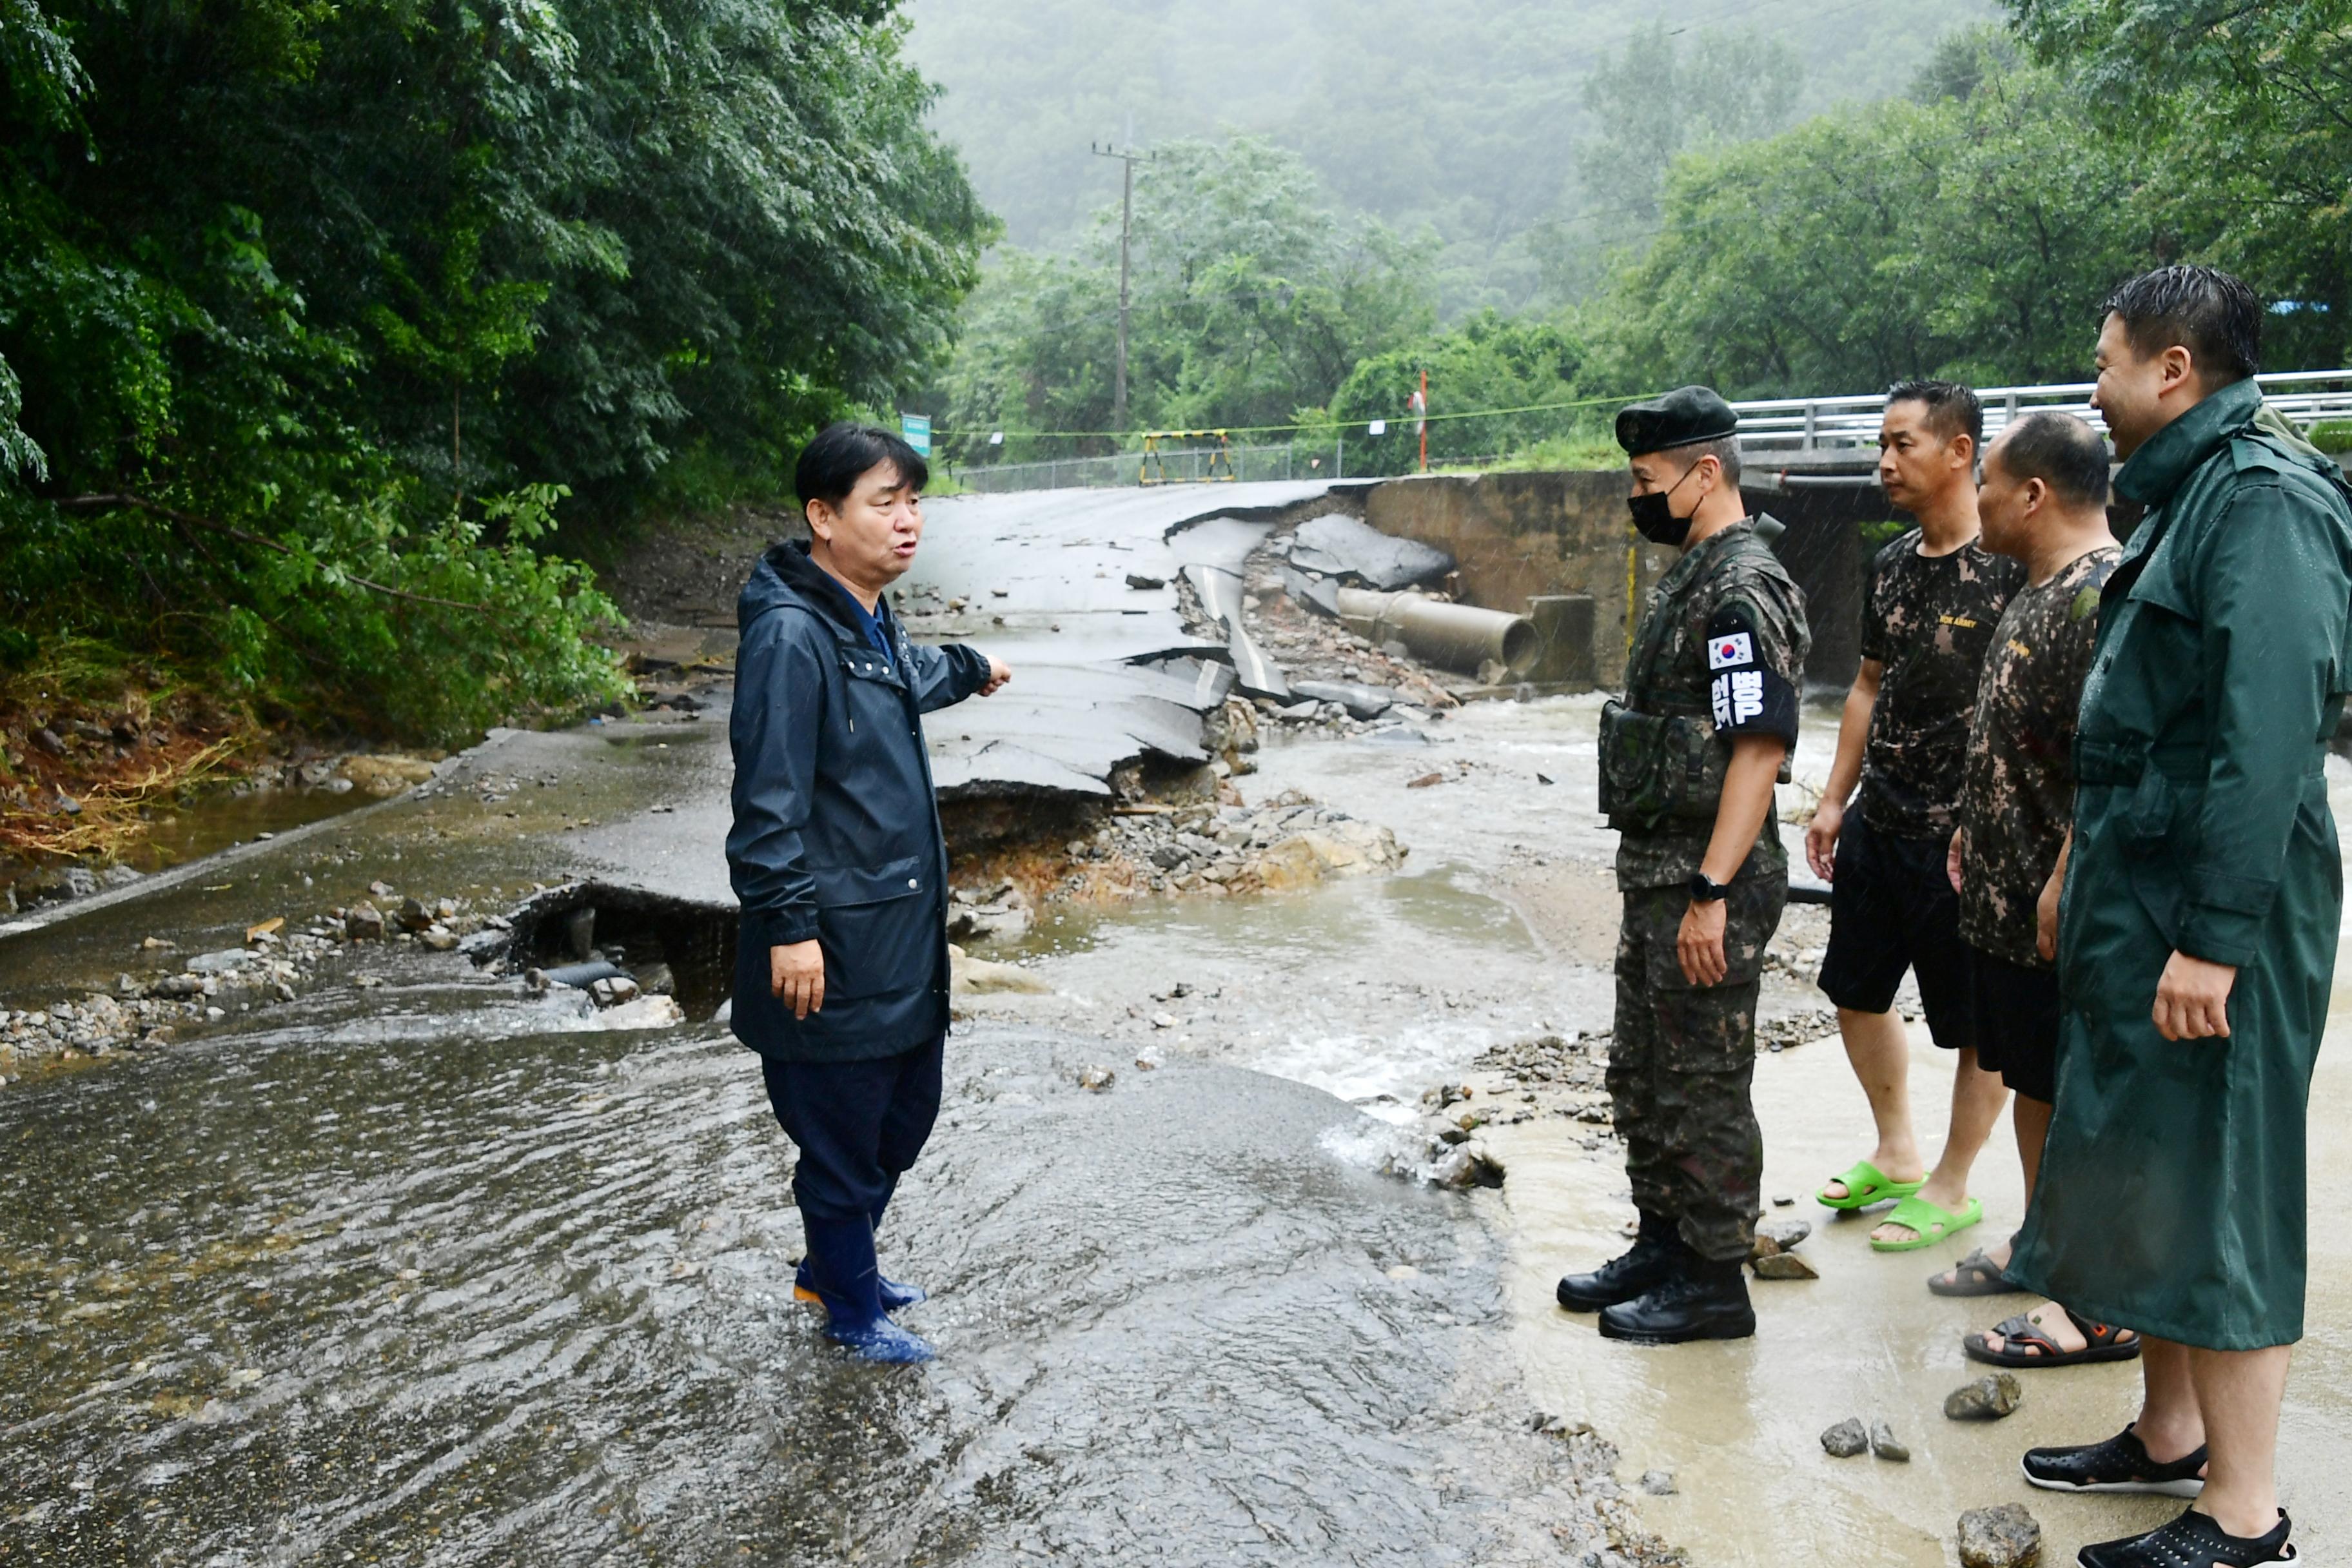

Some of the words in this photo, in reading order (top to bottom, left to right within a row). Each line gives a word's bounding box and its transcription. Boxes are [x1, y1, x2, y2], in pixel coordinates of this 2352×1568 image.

[1954, 617, 1977, 629] ARMY
[1711, 671, 1763, 710] 헌병
[1713, 701, 1763, 731] MP
